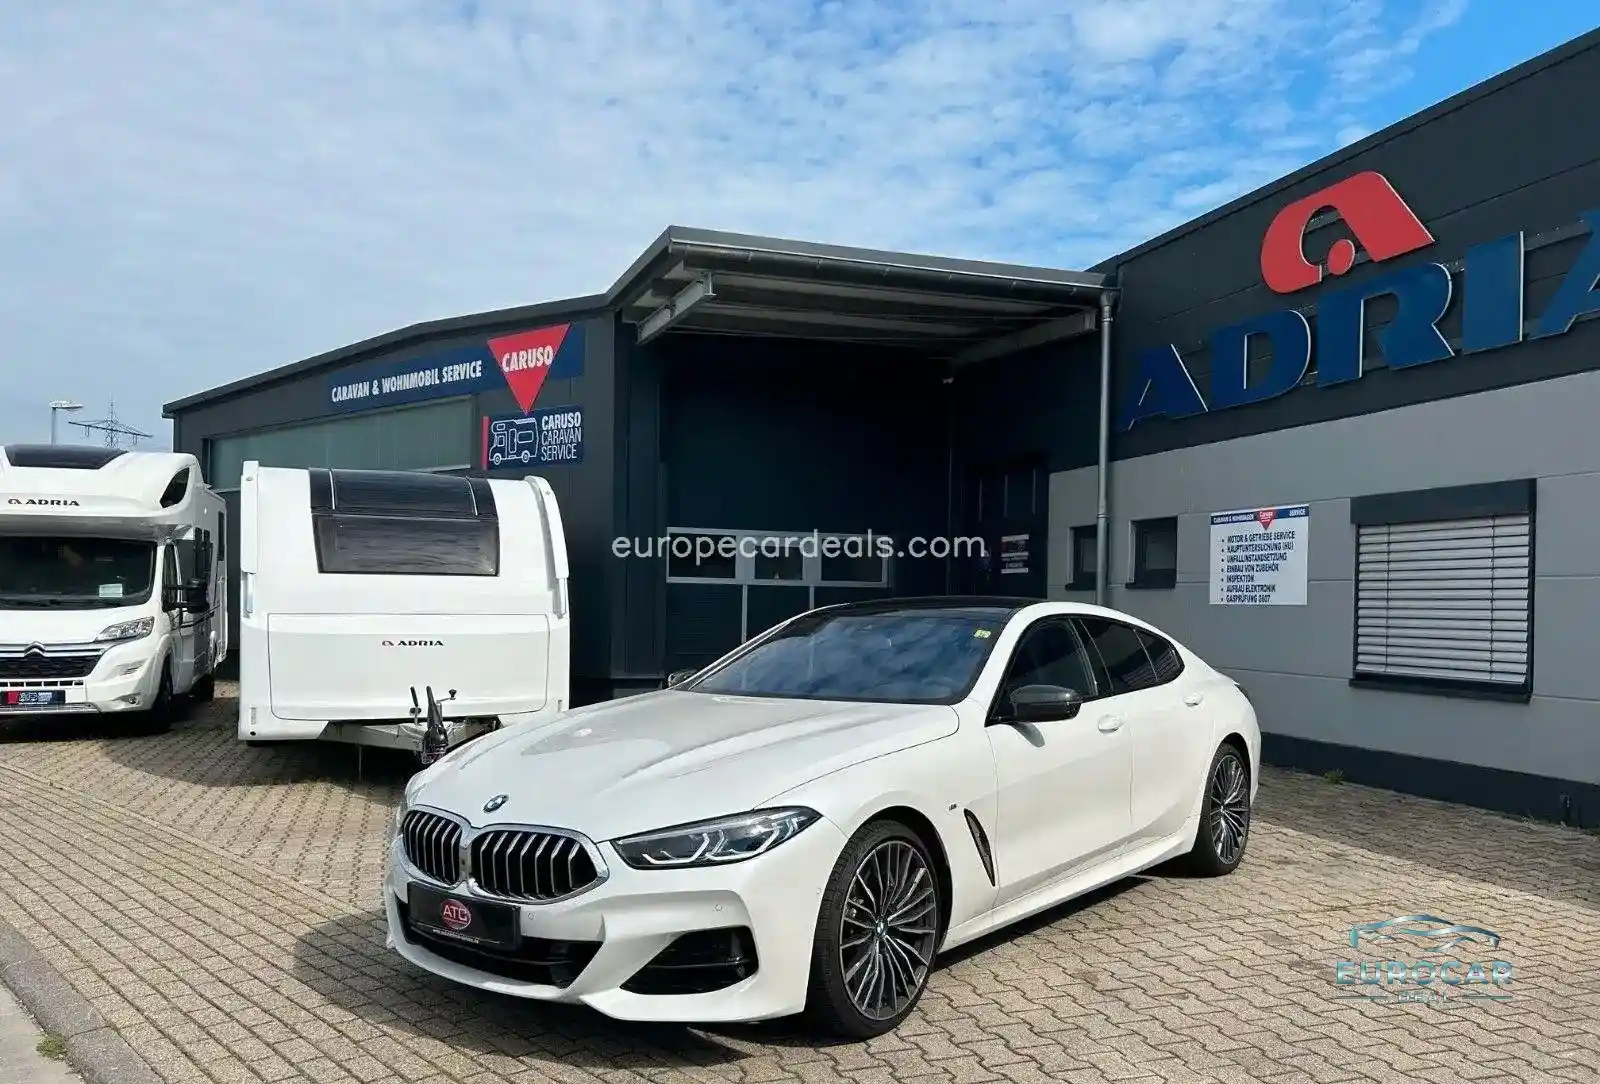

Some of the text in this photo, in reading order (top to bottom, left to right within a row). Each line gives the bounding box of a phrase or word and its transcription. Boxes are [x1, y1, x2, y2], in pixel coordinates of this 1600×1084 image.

[501, 344, 554, 373] CARUSO
[331, 360, 482, 403] CARAVAN & WOHNMOBIL SERVICE
[541, 411, 582, 430] CARUSO
[541, 427, 582, 446] CARAVAN
[541, 443, 577, 461] SERVICE
[1227, 534, 1244, 543] MOTOR
[1249, 532, 1273, 542] GETRIEBE
[1274, 530, 1296, 540] SERVICE
[1226, 565, 1244, 573] EINBAU
[1244, 564, 1255, 573] VON
[1226, 574, 1255, 583] INSPEKTION
